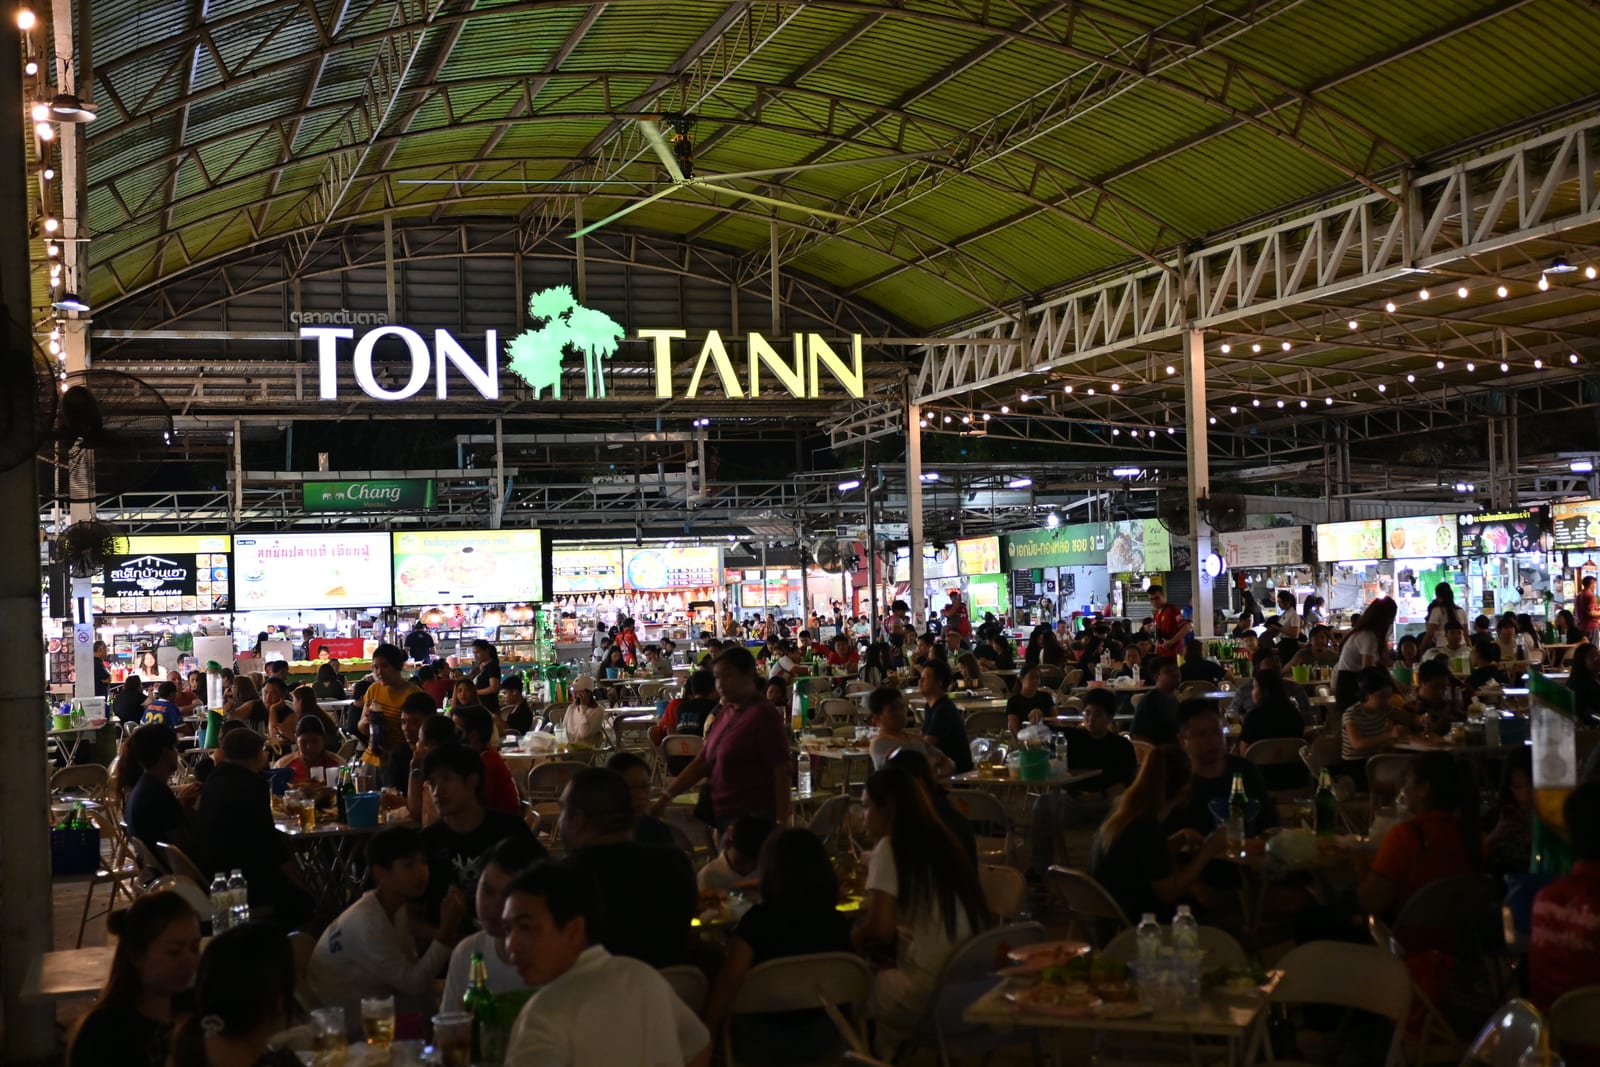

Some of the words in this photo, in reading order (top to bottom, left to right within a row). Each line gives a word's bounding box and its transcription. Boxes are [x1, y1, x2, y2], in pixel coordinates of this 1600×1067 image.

[290, 308, 388, 325] ตลาดต้นตาล
[300, 325, 499, 401] TON
[637, 328, 864, 399] TANN
[347, 483, 401, 502] Chang
[257, 539, 327, 564] ลูกชิ้นปลาแท้
[1072, 538, 1087, 553] ซอย
[1089, 535, 1095, 552] 3
